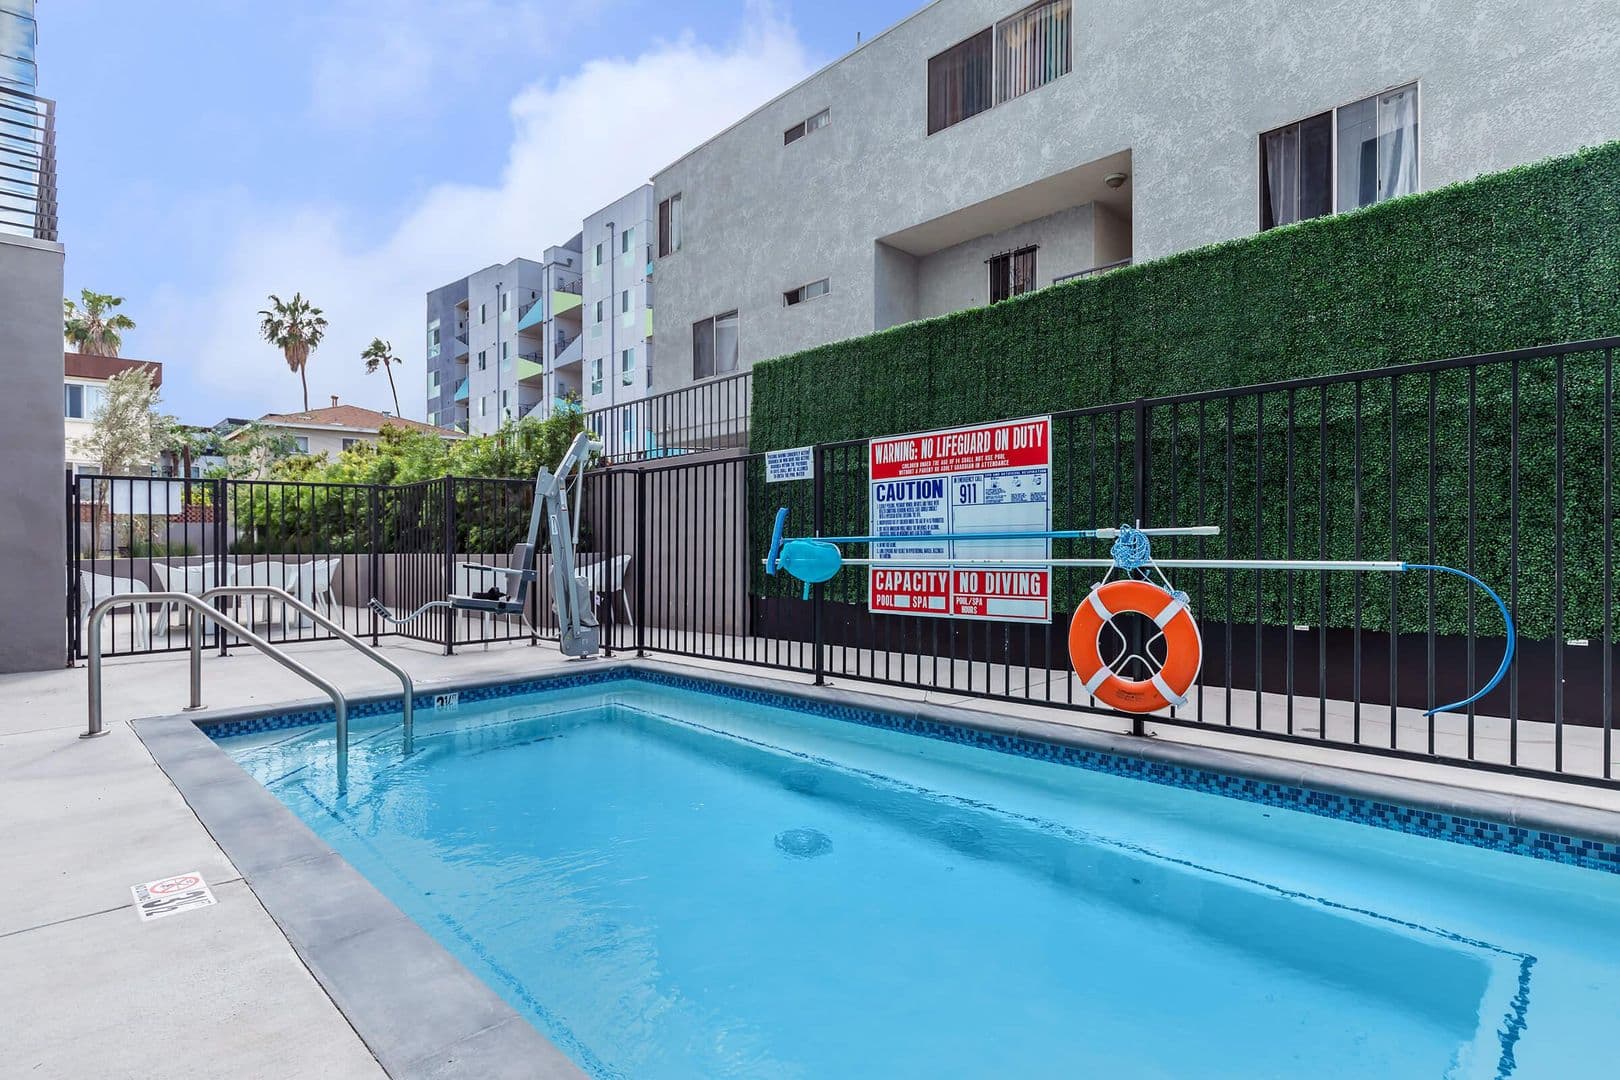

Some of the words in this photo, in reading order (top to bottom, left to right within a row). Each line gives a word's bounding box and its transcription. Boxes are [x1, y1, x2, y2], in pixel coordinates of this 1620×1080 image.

[875, 441, 918, 465] WARNING:
[921, 438, 934, 459] NO
[936, 432, 991, 458] LIFEGUARD
[995, 428, 1008, 451] ON
[1013, 424, 1044, 450] DUTY
[876, 479, 943, 502] CAUTION
[959, 483, 977, 504] 911
[875, 571, 948, 593] CAPACITY
[959, 572, 978, 593] NO
[985, 573, 1041, 595] DIVING
[876, 594, 894, 607] POOL
[912, 596, 928, 609] SPA
[961, 605, 978, 614] HOURS
